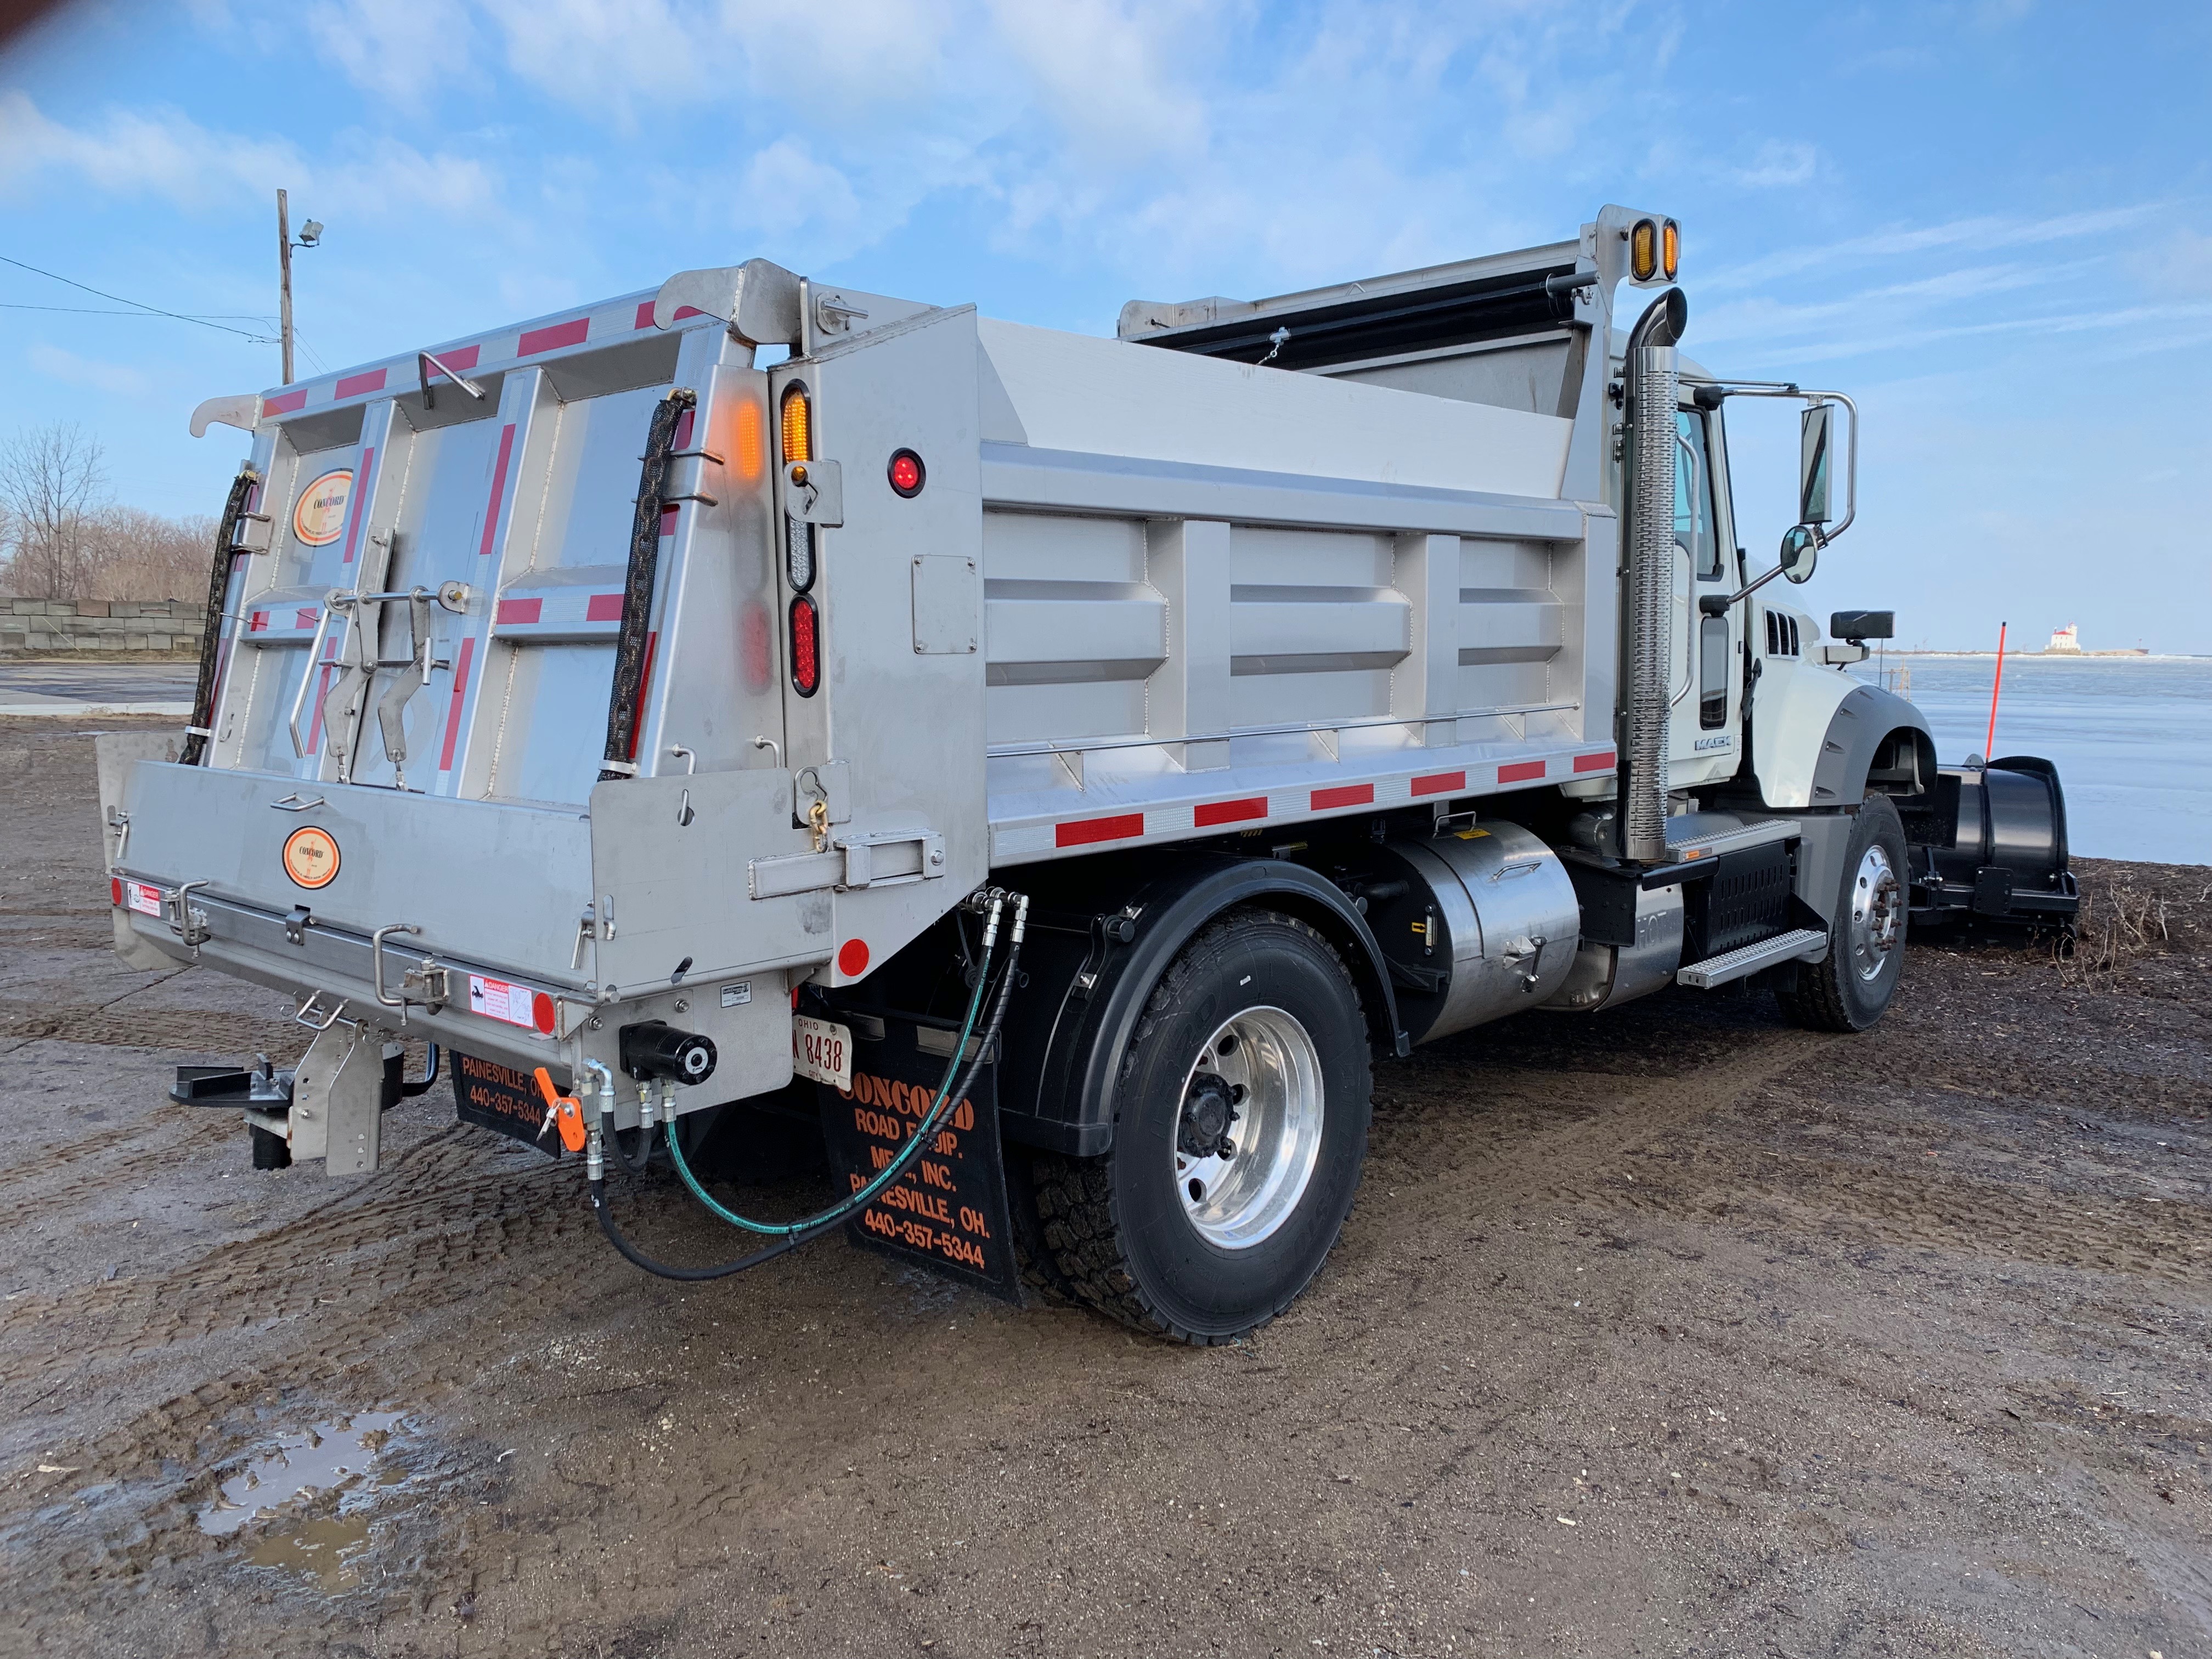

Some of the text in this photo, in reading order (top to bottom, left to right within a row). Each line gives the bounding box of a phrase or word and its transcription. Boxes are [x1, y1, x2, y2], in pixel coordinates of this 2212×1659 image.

[314, 495, 345, 509] CONCORD
[299, 846, 323, 859] CONCORD
[488, 981, 509, 992] DANGER
[798, 1018, 819, 1030] OHIO
[805, 1034, 842, 1072] 8438
[462, 1056, 527, 1096] PAINESVILLE,
[470, 1085, 541, 1127] 440-357-5344
[855, 1108, 900, 1141] ROAD
[906, 1121, 963, 1159] EUIP.
[870, 1145, 957, 1192] MF., INC.
[850, 1173, 990, 1239] PAESVILLE, OH.
[865, 1208, 985, 1269] 440-357-5344
